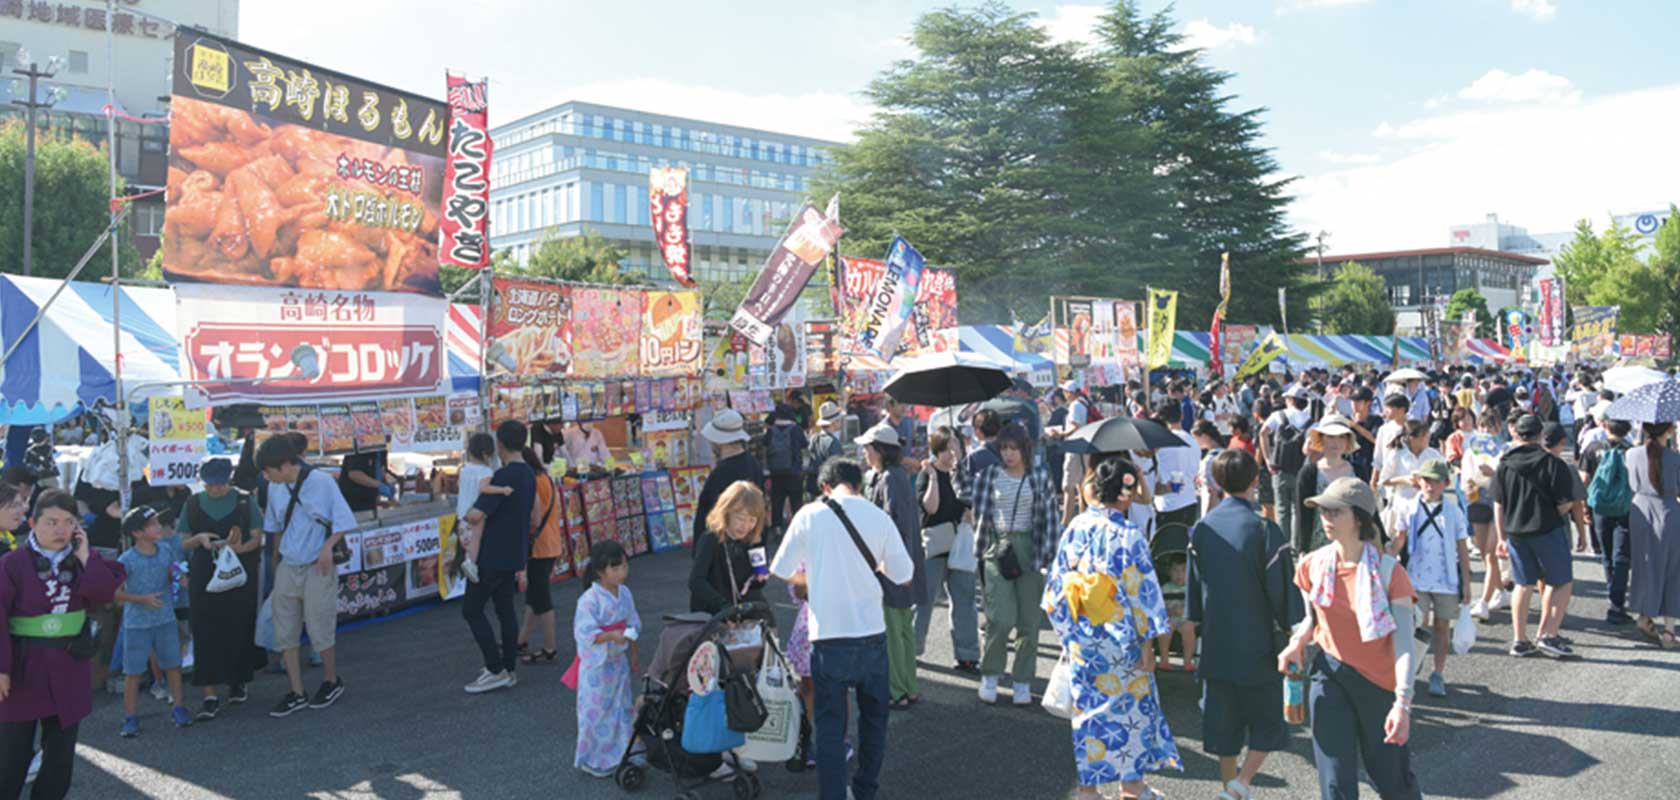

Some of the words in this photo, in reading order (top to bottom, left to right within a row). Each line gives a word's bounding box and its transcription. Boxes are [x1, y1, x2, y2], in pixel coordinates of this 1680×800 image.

[243, 57, 444, 146] 高崎ほるもん
[448, 118, 487, 263] たこやき
[280, 293, 375, 322] 高崎名物
[508, 287, 569, 308] 北海道バタ
[863, 261, 903, 349] LEMONADE
[508, 307, 567, 326] ロングポテト
[151, 443, 193, 454] ハイボール
